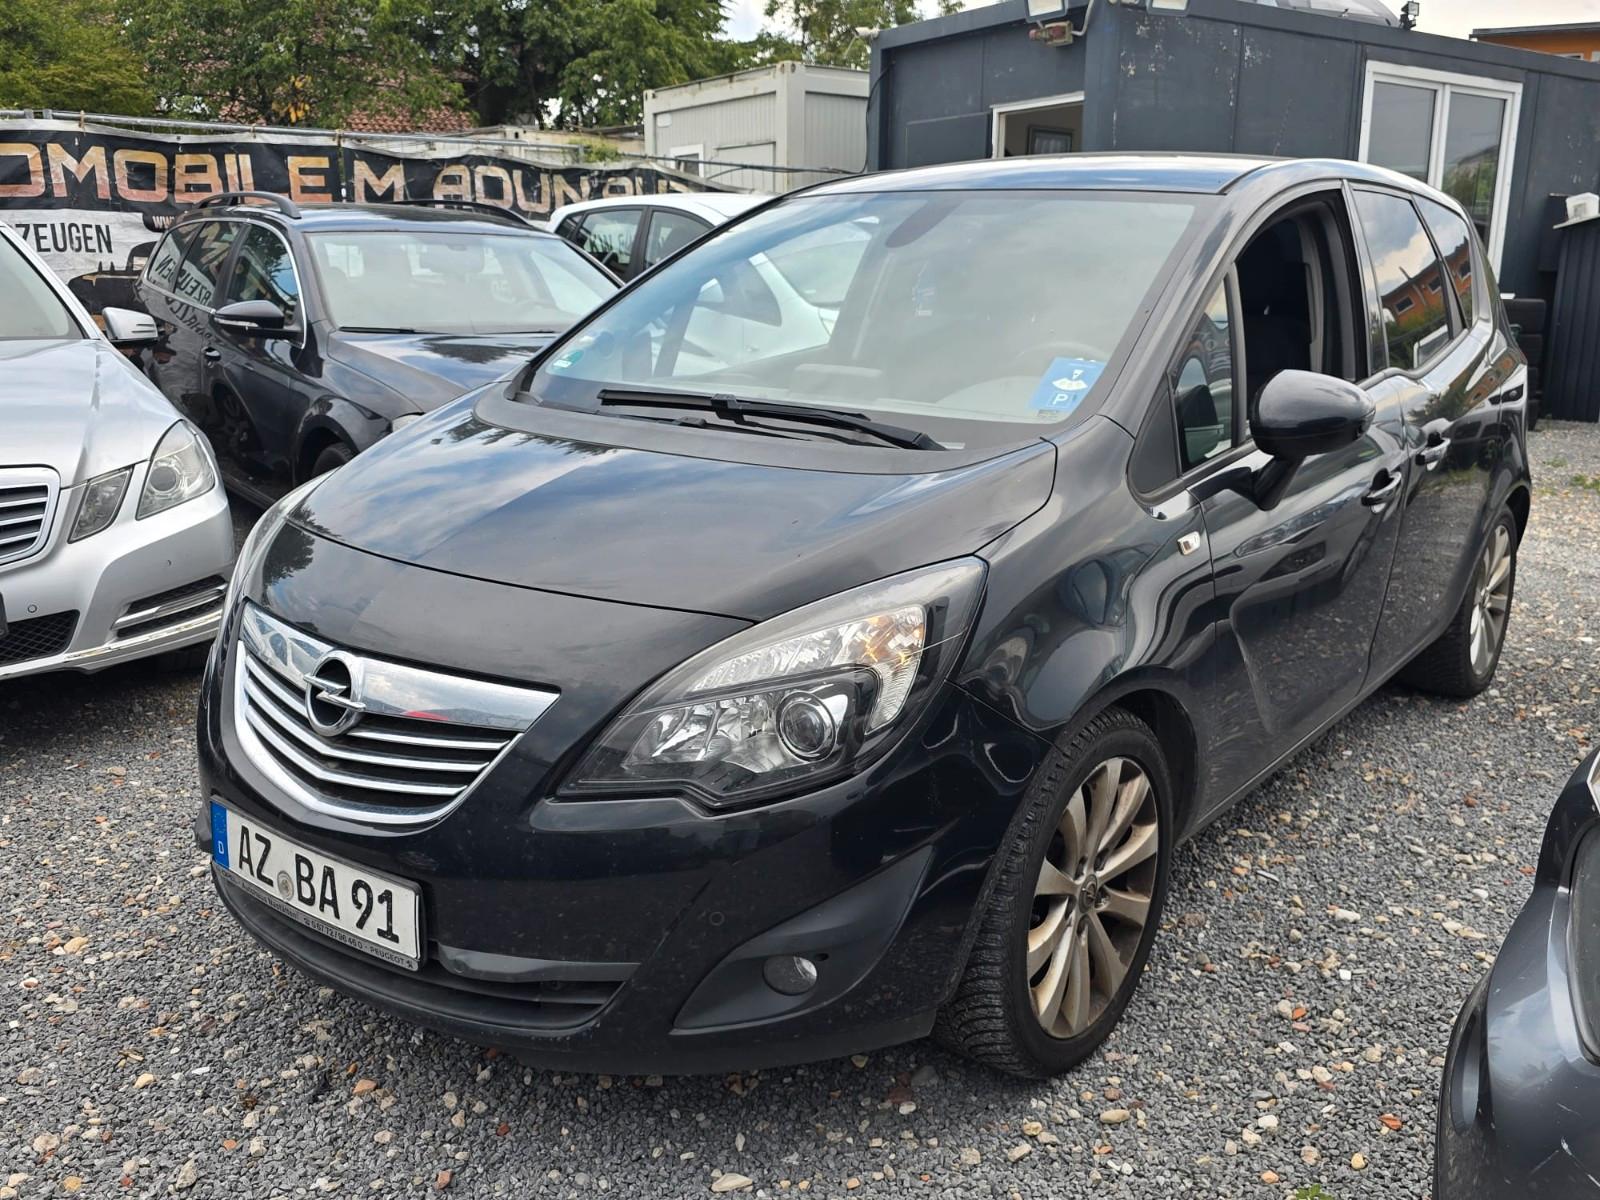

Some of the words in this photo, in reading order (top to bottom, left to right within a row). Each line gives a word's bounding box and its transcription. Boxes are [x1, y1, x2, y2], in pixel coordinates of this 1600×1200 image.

[238, 825, 274, 887] AZ
[295, 853, 341, 920] BA
[351, 879, 399, 944] 91
